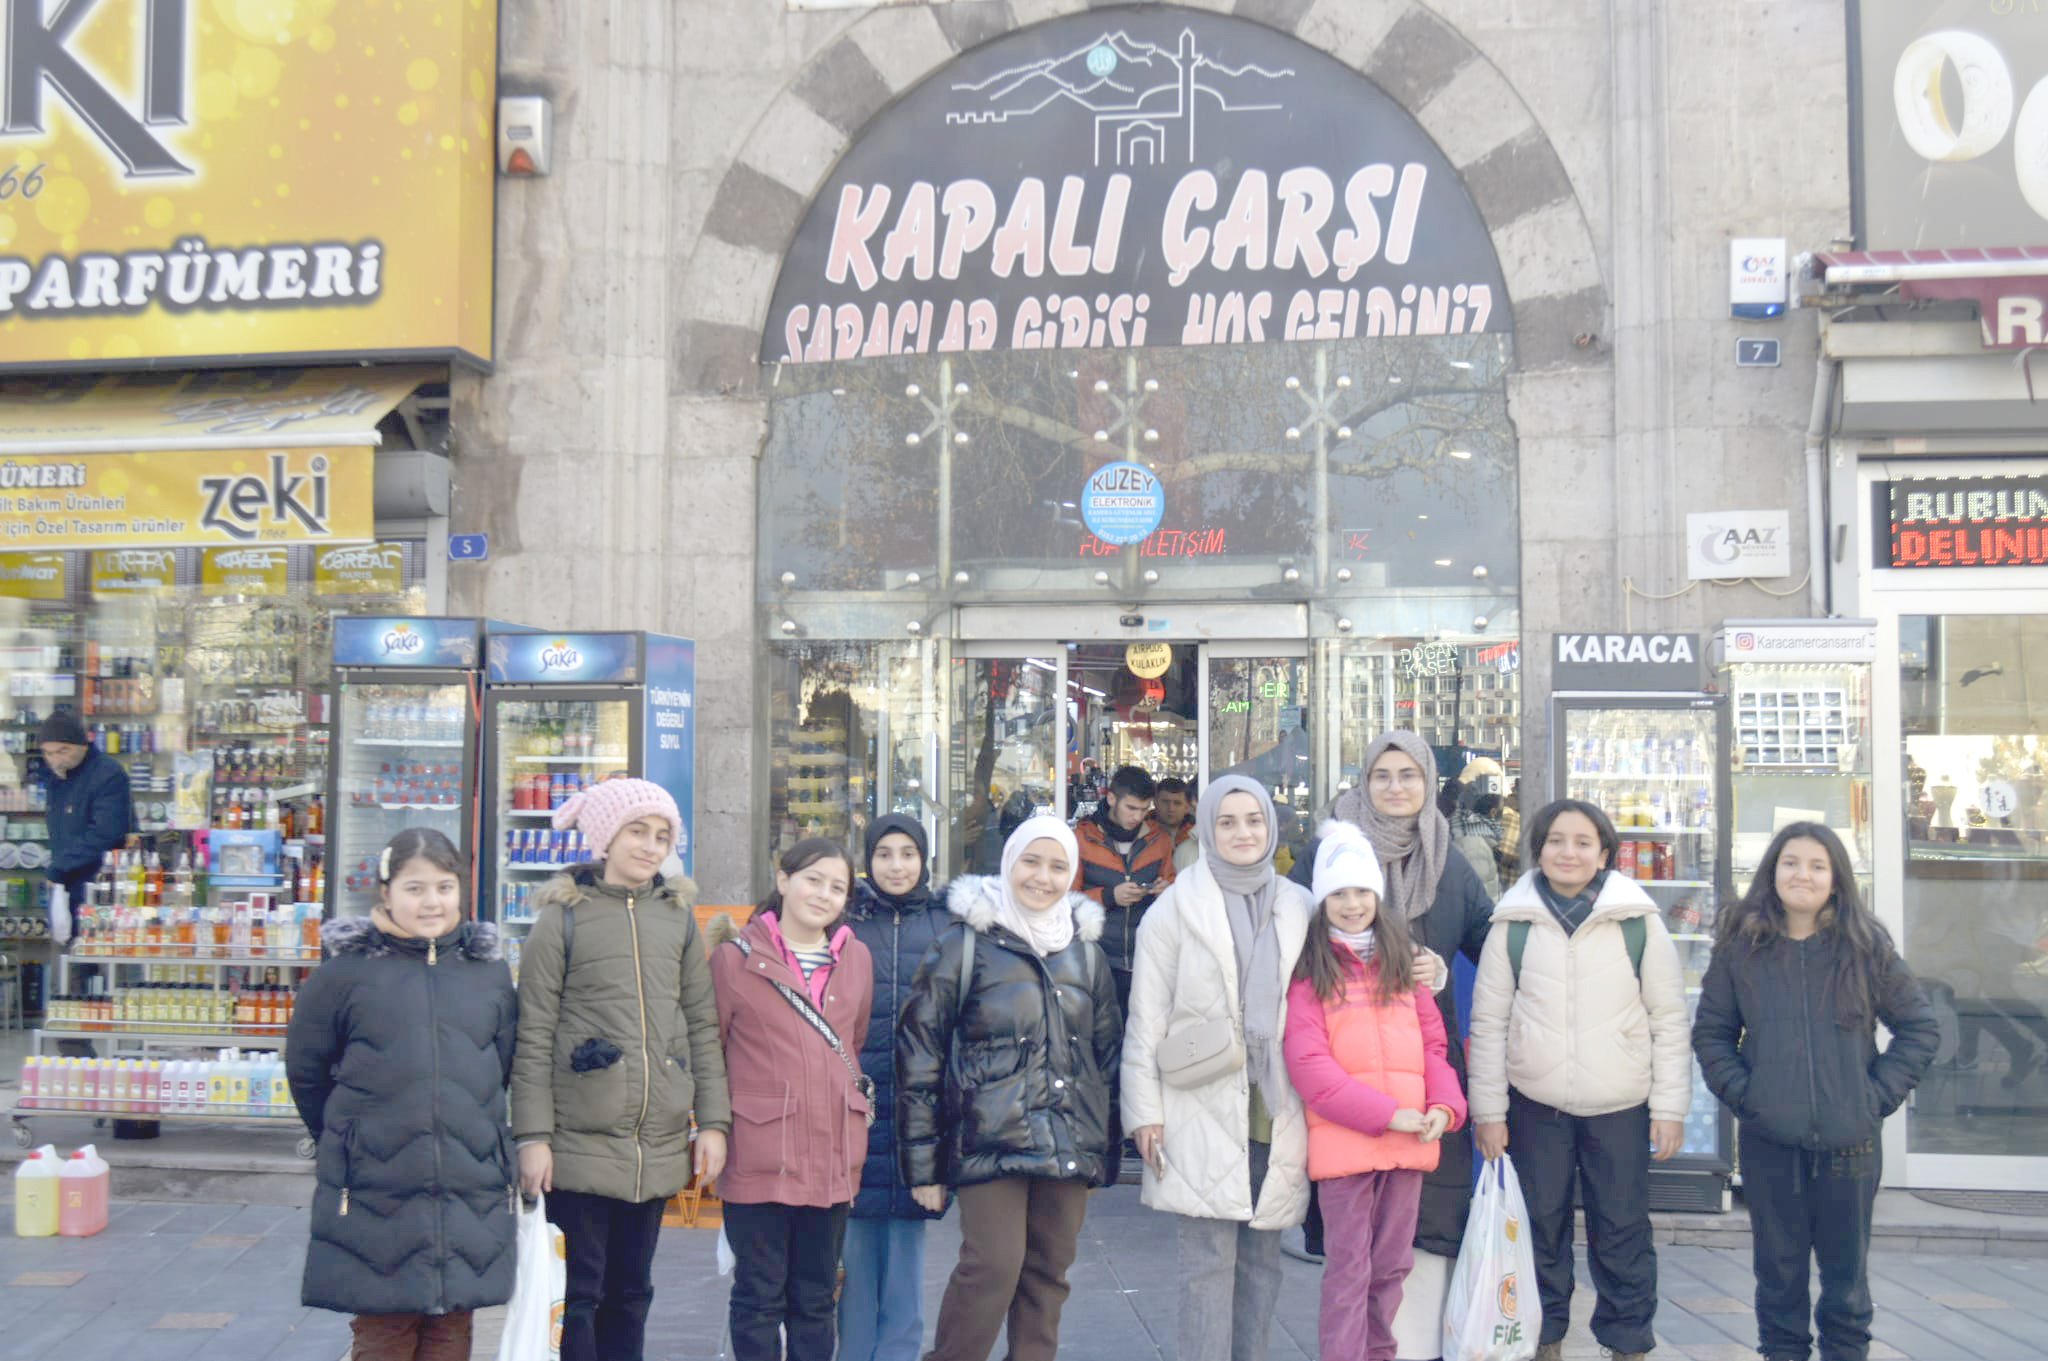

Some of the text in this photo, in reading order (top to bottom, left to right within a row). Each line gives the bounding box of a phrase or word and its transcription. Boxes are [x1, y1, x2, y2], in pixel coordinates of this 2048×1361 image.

[825, 162, 1428, 291] KAPALI ÇARŞI
[1752, 344, 1765, 360] 7
[1092, 468, 1154, 492] KUZEY
[17, 497, 61, 511] Bakım
[66, 493, 125, 511] Ürünleri
[6, 517, 184, 538] için Özel Tasarım ürünler
[1723, 528, 1777, 545] AAZ
[462, 540, 472, 554] 5
[1900, 528, 2048, 561] DELINI
[1558, 635, 1694, 663] KARACA
[1757, 634, 1866, 649] Karacamercansarraf
[1405, 657, 1457, 679] KASET
